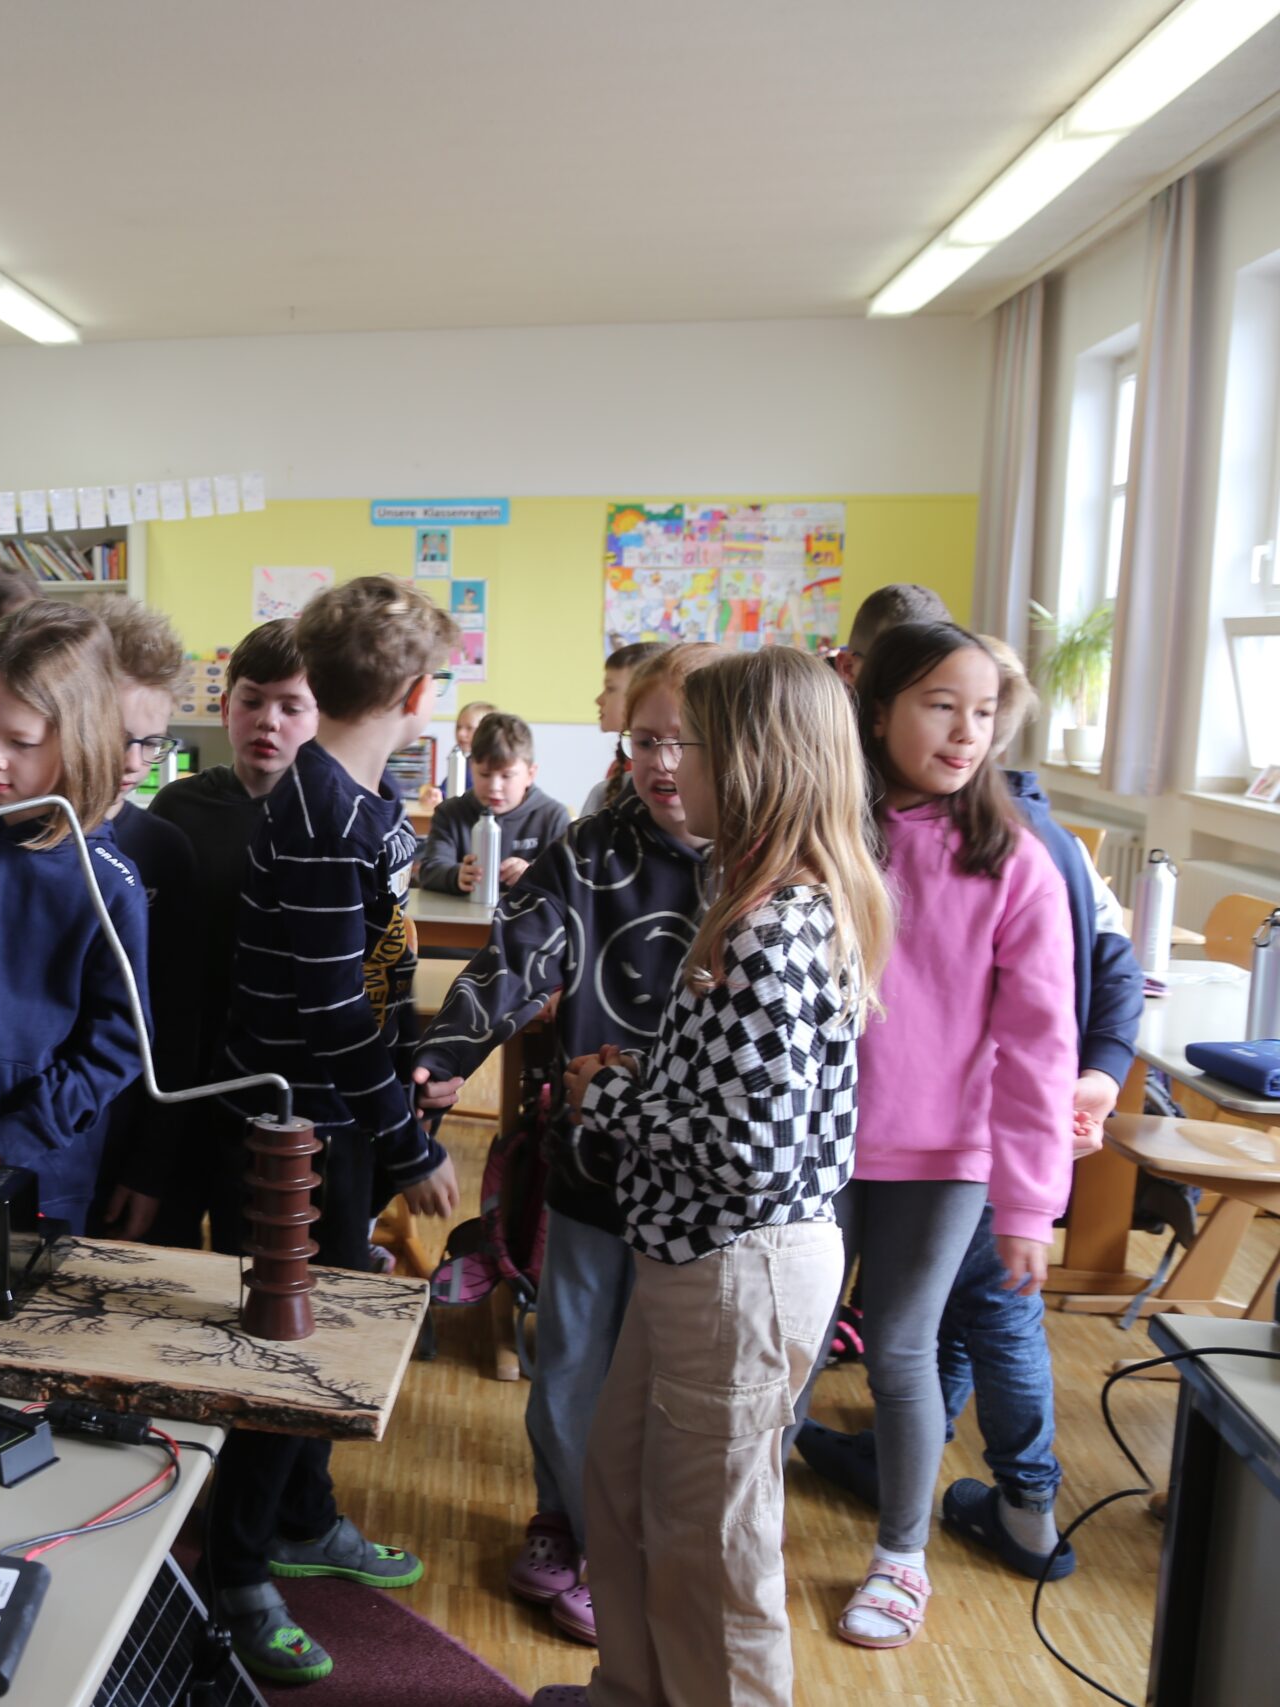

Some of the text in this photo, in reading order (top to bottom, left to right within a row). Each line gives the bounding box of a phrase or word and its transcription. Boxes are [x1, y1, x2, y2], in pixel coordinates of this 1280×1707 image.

[377, 506, 501, 521] Unsere Klassenregeln
[365, 966, 386, 1023] NEW
